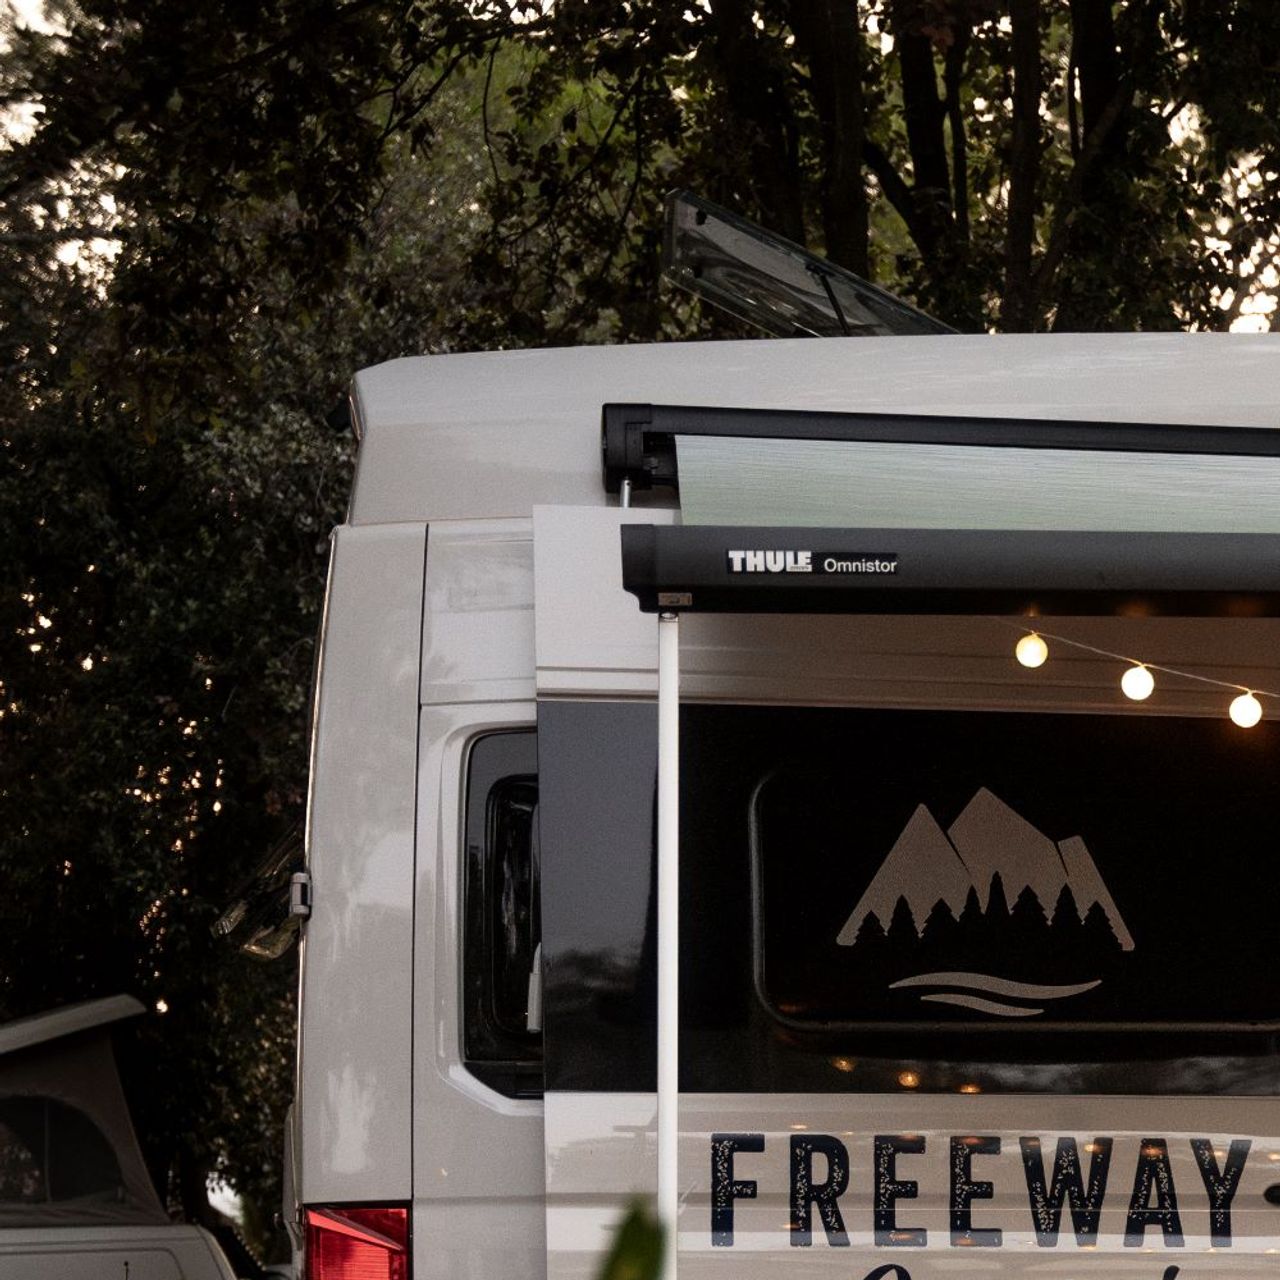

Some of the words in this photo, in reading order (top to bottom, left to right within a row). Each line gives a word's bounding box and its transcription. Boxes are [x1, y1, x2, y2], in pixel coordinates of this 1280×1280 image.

[728, 550, 812, 572] THULE
[824, 558, 898, 573] Omnistor
[710, 1133, 1252, 1248] FREEWAY
